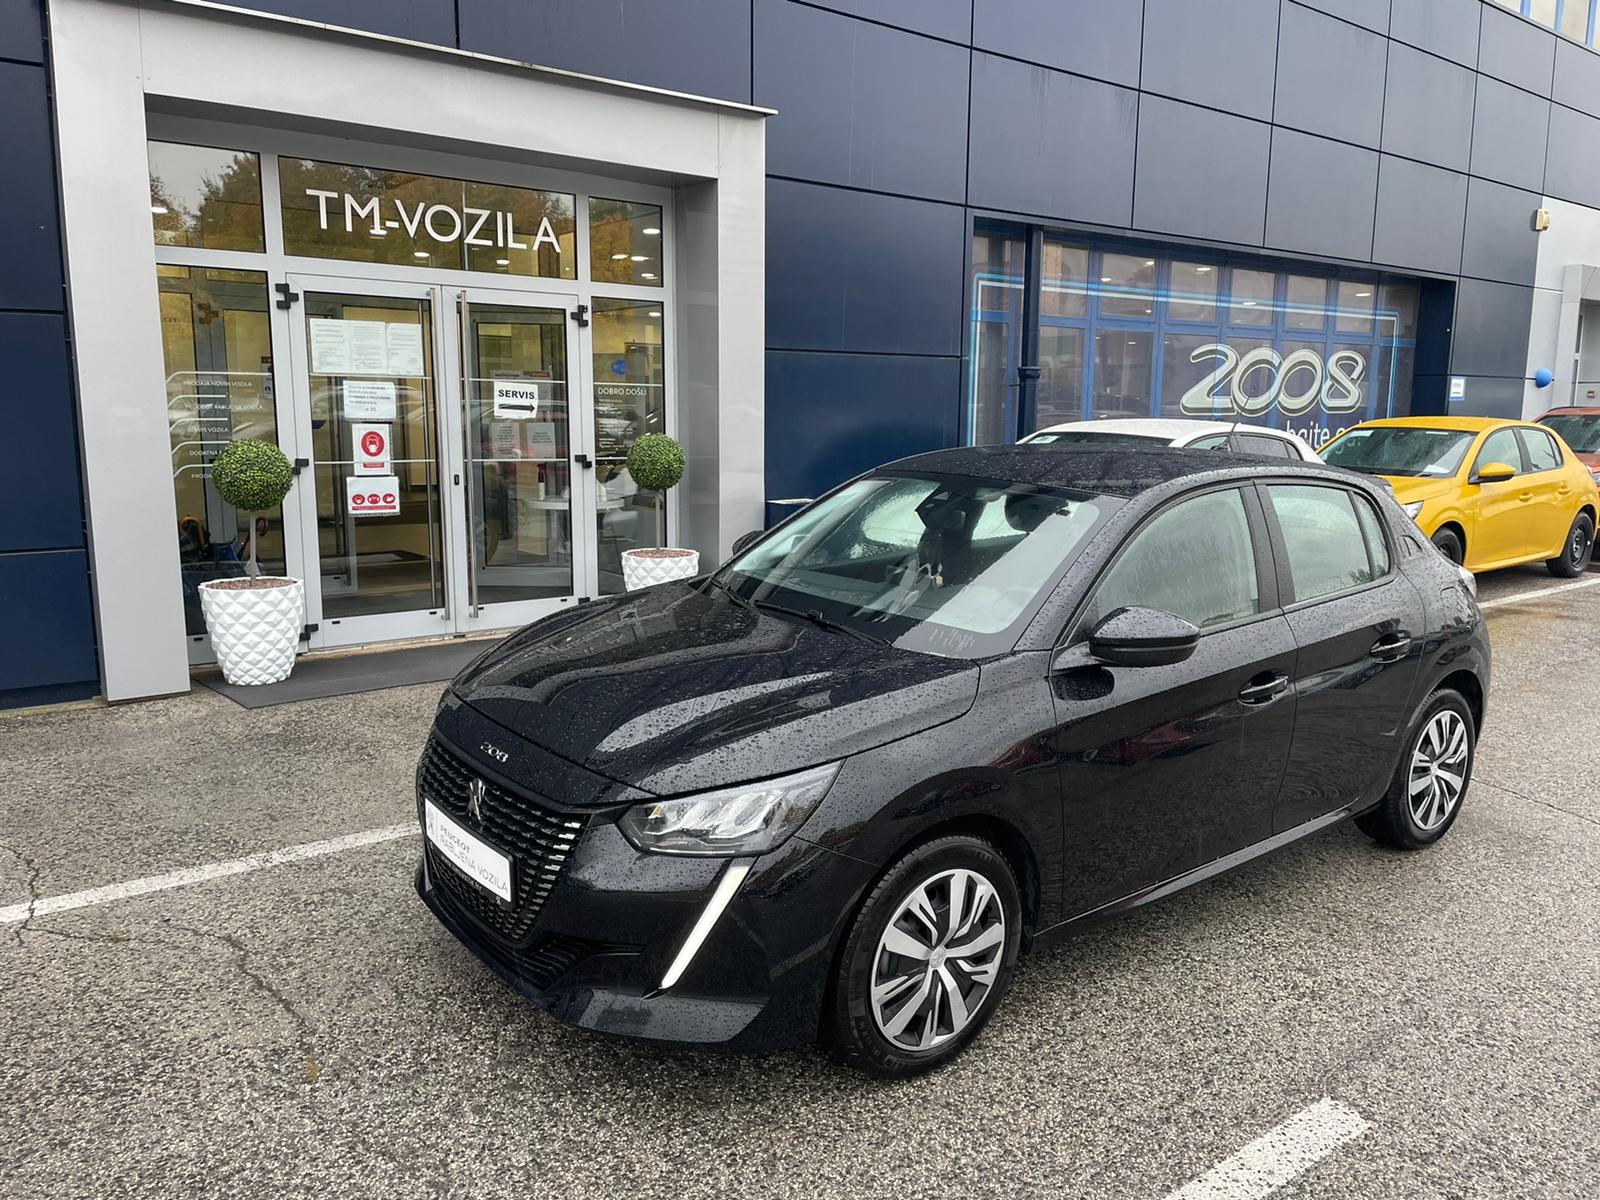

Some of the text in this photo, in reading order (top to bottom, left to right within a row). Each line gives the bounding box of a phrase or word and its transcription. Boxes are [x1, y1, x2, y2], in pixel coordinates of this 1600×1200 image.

[305, 188, 562, 253] TM-VOZILA
[597, 387, 625, 395] DOBRO
[1179, 343, 1367, 417] 2008
[498, 389, 535, 400] SERVIS
[480, 741, 509, 763] 208
[477, 864, 509, 894] VOZILA
